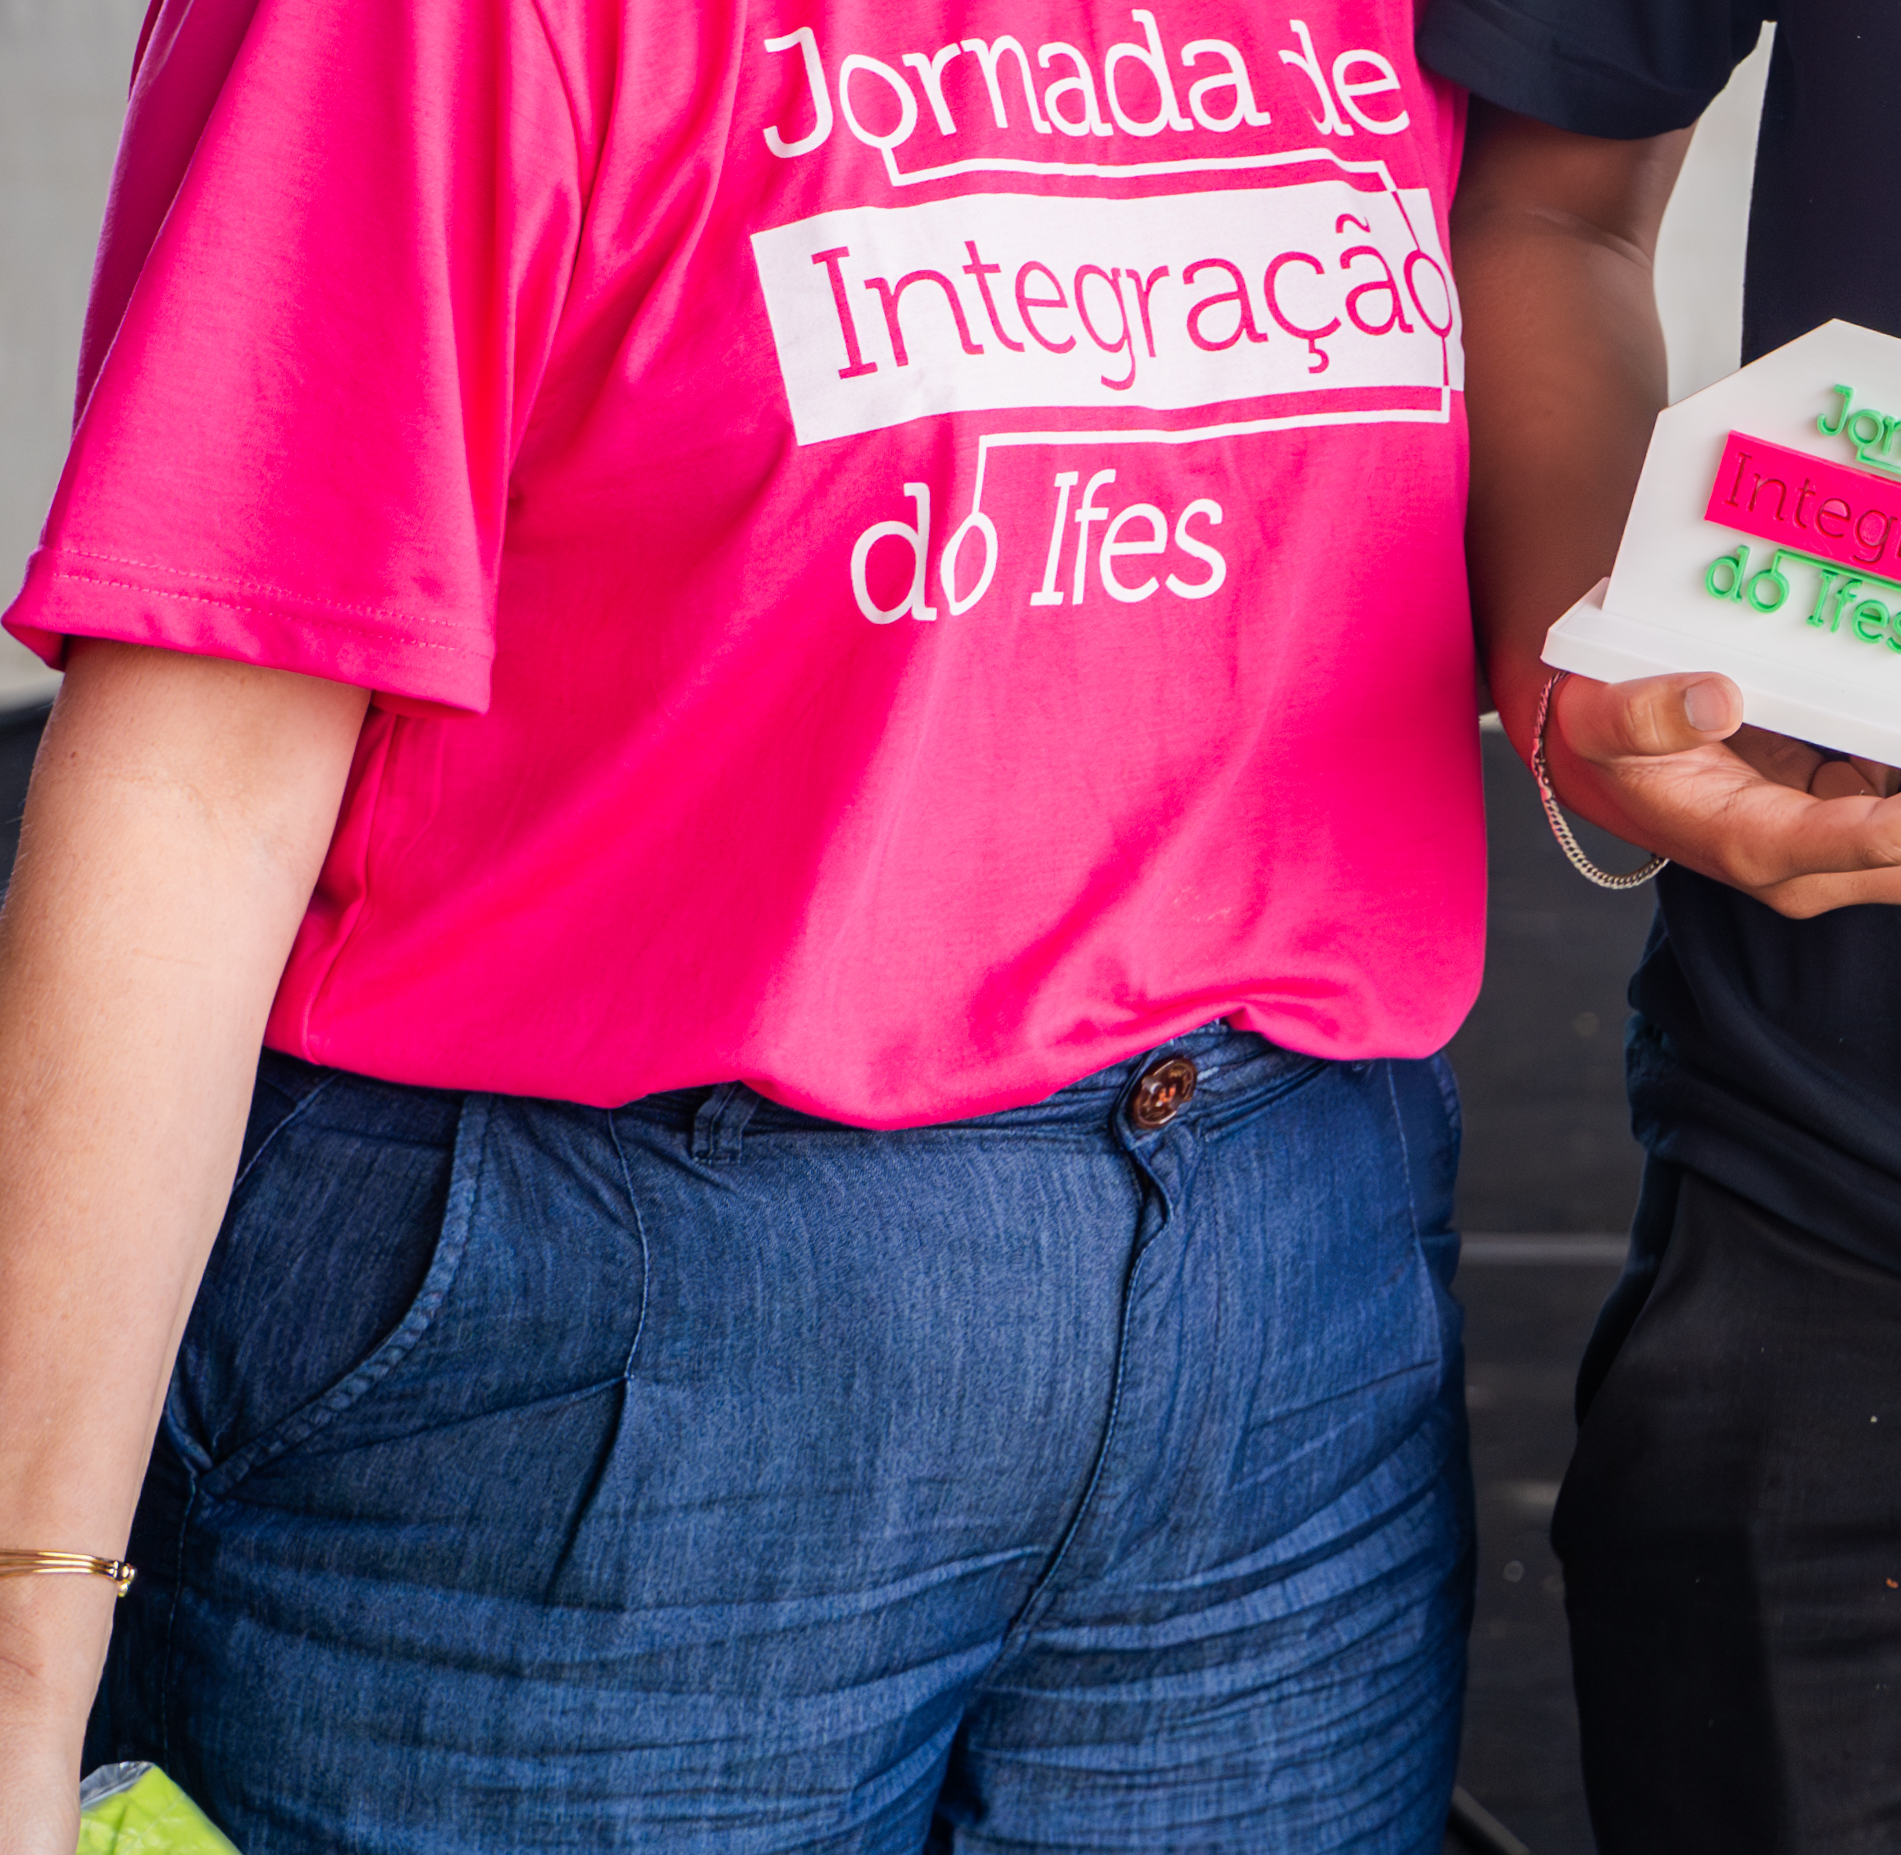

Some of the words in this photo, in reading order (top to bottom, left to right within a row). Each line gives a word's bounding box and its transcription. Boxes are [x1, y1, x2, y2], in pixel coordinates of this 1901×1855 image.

[763, 8, 1270, 159] Jornada
[811, 212, 1453, 390] Integração
[850, 481, 998, 625] do
[1030, 468, 1227, 606] Ifes
[1704, 545, 1790, 613] do
